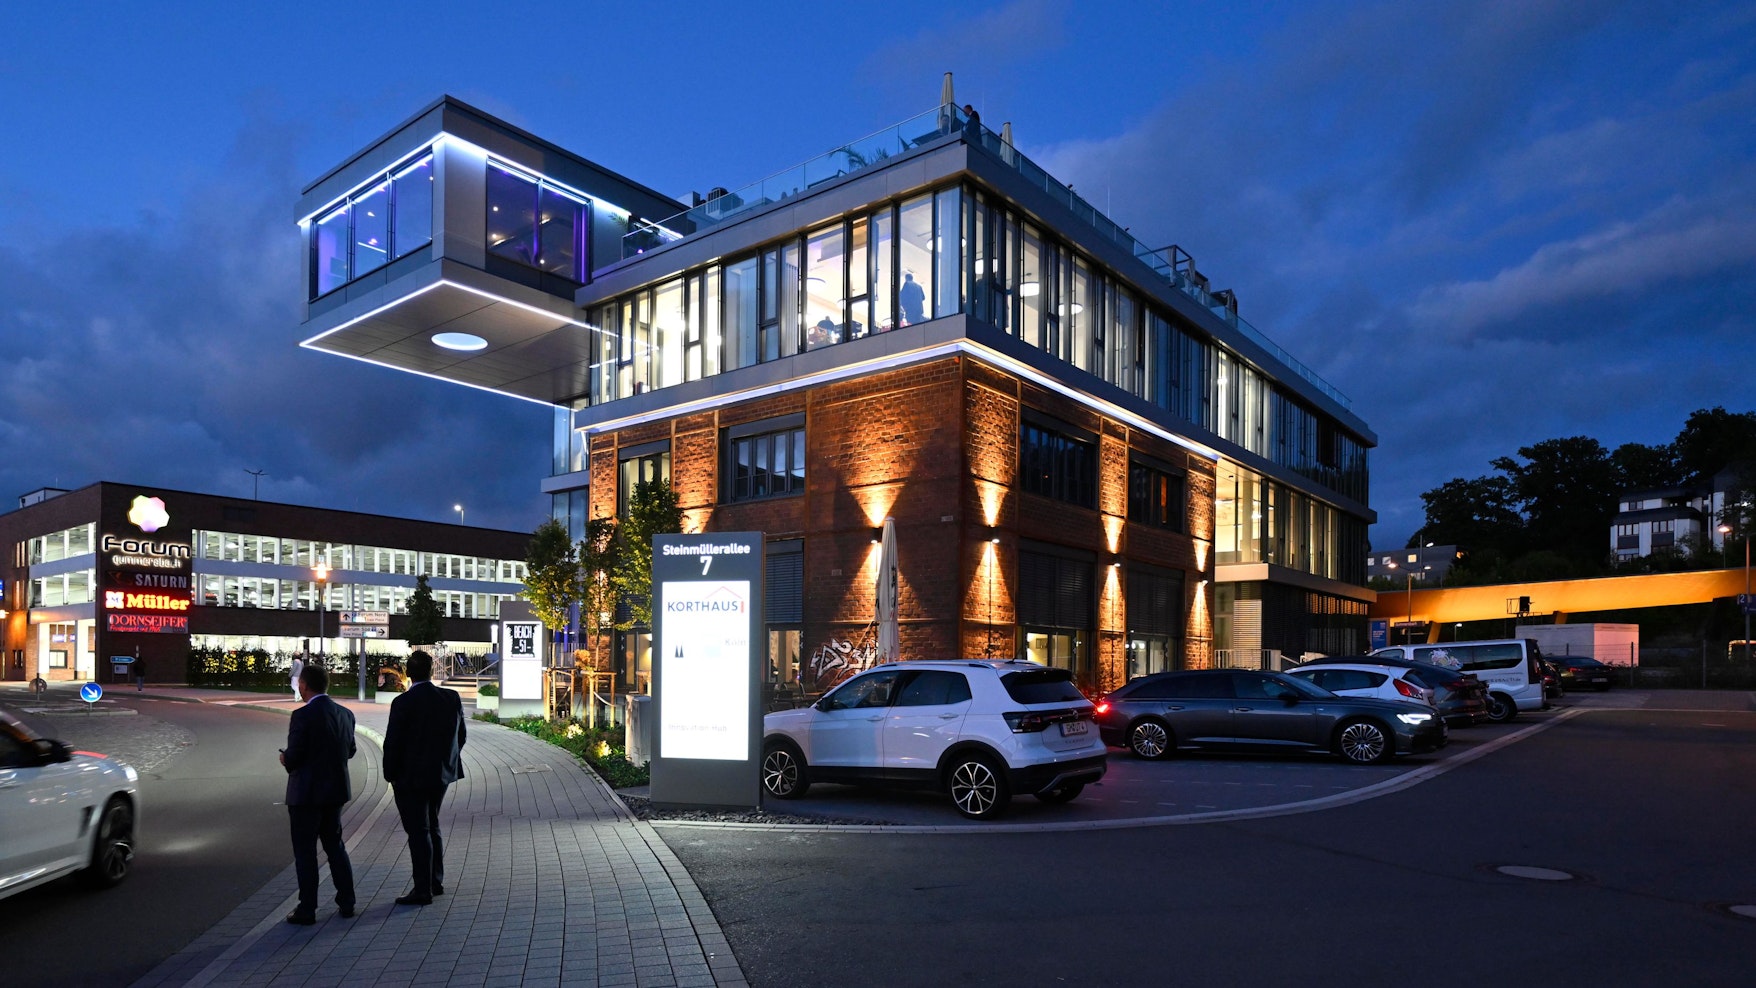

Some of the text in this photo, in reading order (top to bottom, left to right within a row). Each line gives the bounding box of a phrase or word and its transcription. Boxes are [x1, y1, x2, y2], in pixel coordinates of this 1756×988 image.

[103, 535, 191, 558] Forum
[662, 542, 751, 556] Steinmüllerallee
[699, 556, 713, 576] 7
[135, 573, 187, 588] SATURN
[126, 593, 190, 610] Müller
[667, 600, 738, 612] KORTHAUS
[514, 625, 532, 638] BEACH
